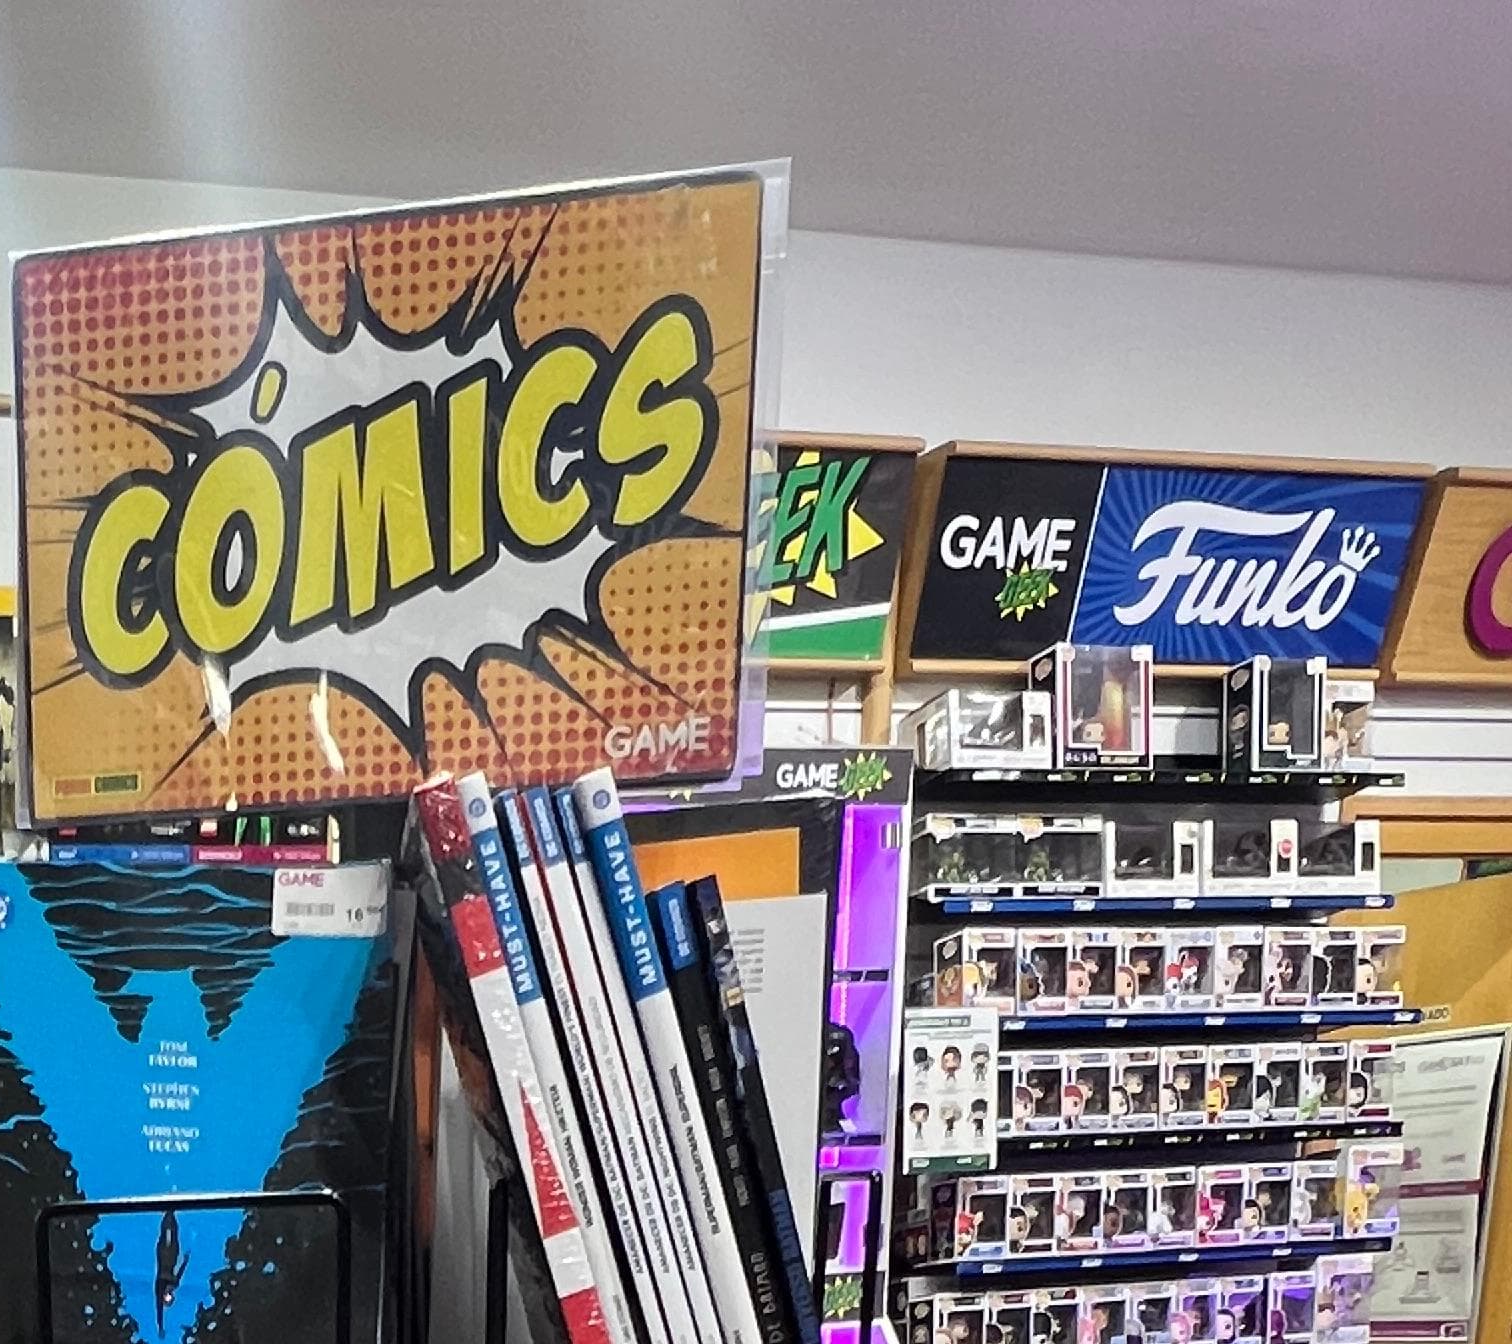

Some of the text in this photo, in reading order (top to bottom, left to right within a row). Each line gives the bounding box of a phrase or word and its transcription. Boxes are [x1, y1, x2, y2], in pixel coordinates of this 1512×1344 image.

[81, 312, 705, 674] CÓMICS
[939, 516, 1076, 571] GAME
[1114, 500, 1358, 631] Funko
[602, 717, 711, 760] GAME
[775, 762, 838, 790] GAME
[278, 871, 325, 888] GAME
[481, 842, 534, 995] MUST-HAVE
[603, 832, 658, 988] MUST-HAVE
